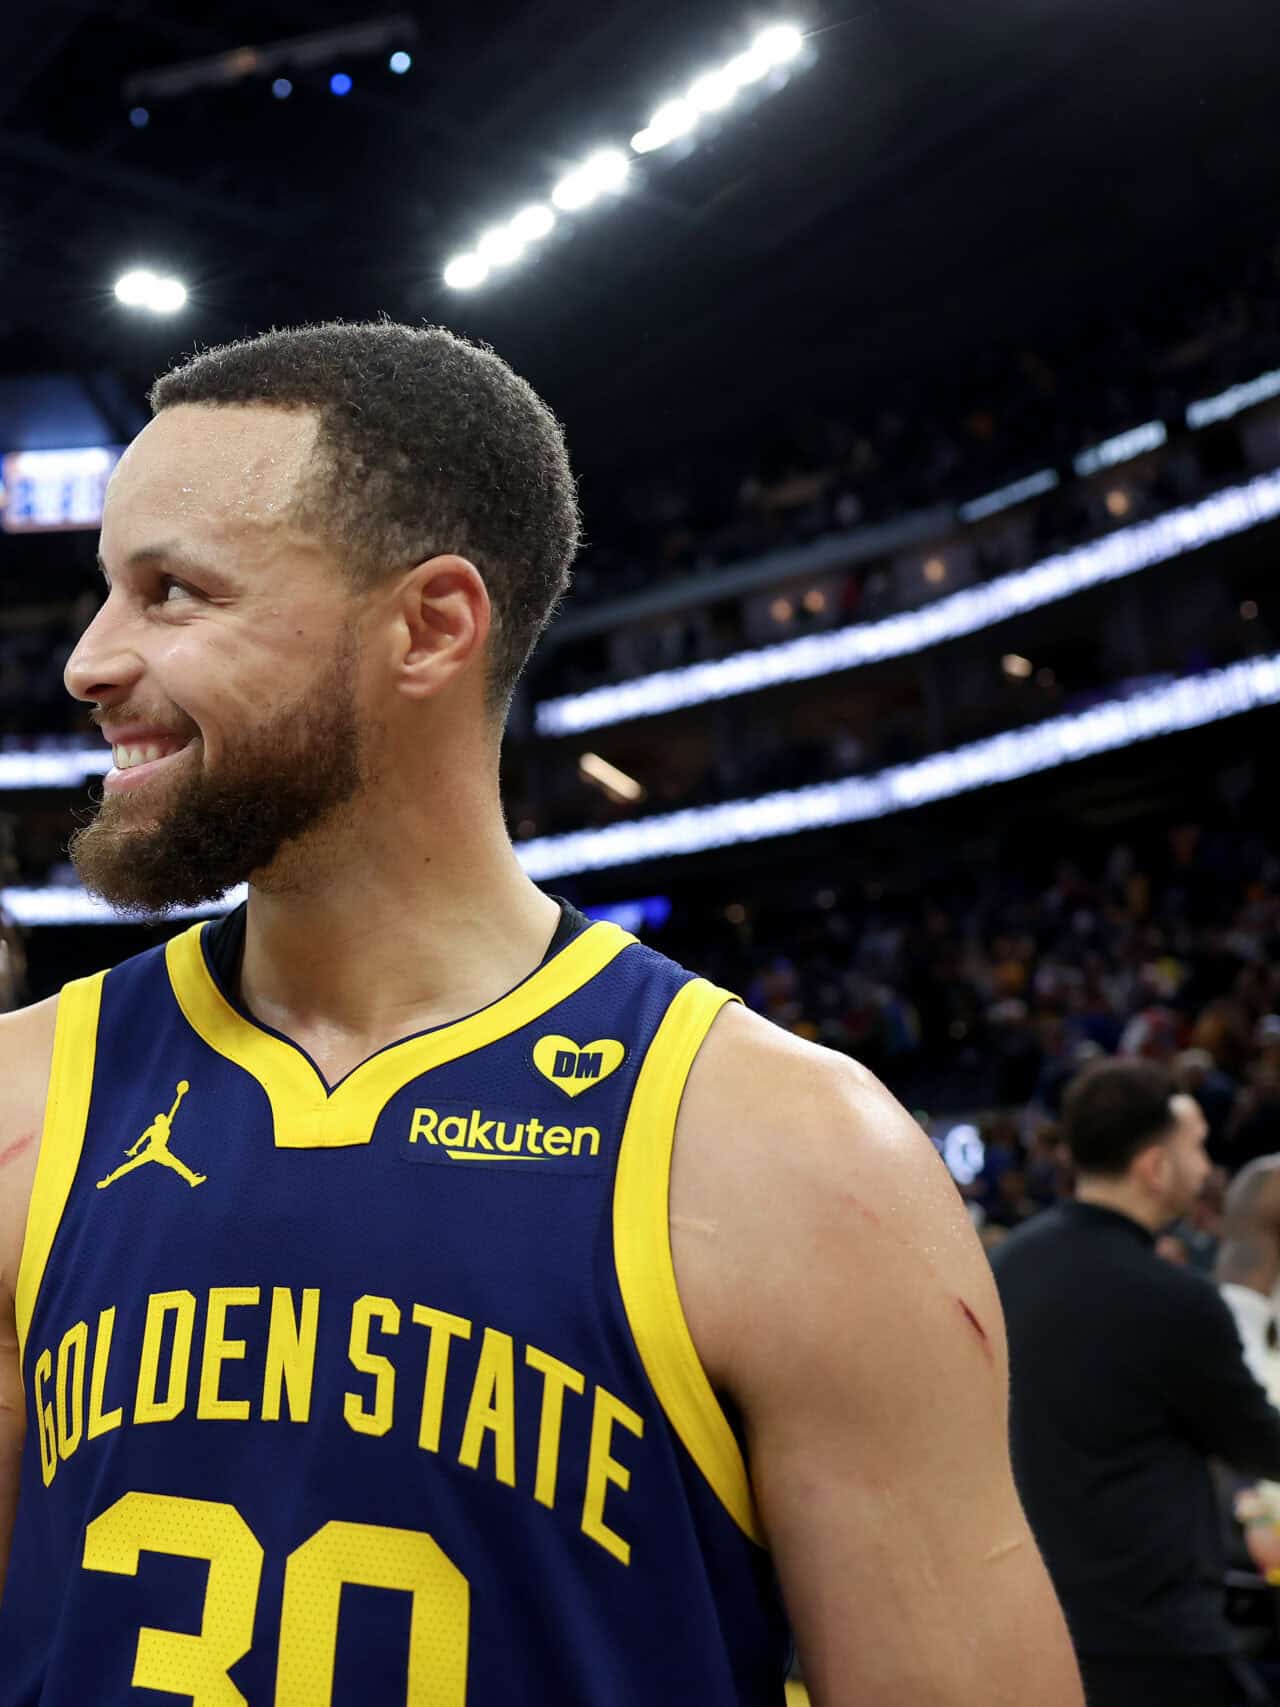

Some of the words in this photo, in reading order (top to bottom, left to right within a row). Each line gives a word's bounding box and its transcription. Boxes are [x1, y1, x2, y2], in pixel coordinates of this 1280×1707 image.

[552, 1051, 603, 1078] DM
[408, 1107, 601, 1156] Rakuten
[34, 1286, 320, 1488] GOLDEN
[343, 1294, 644, 1566] STATE
